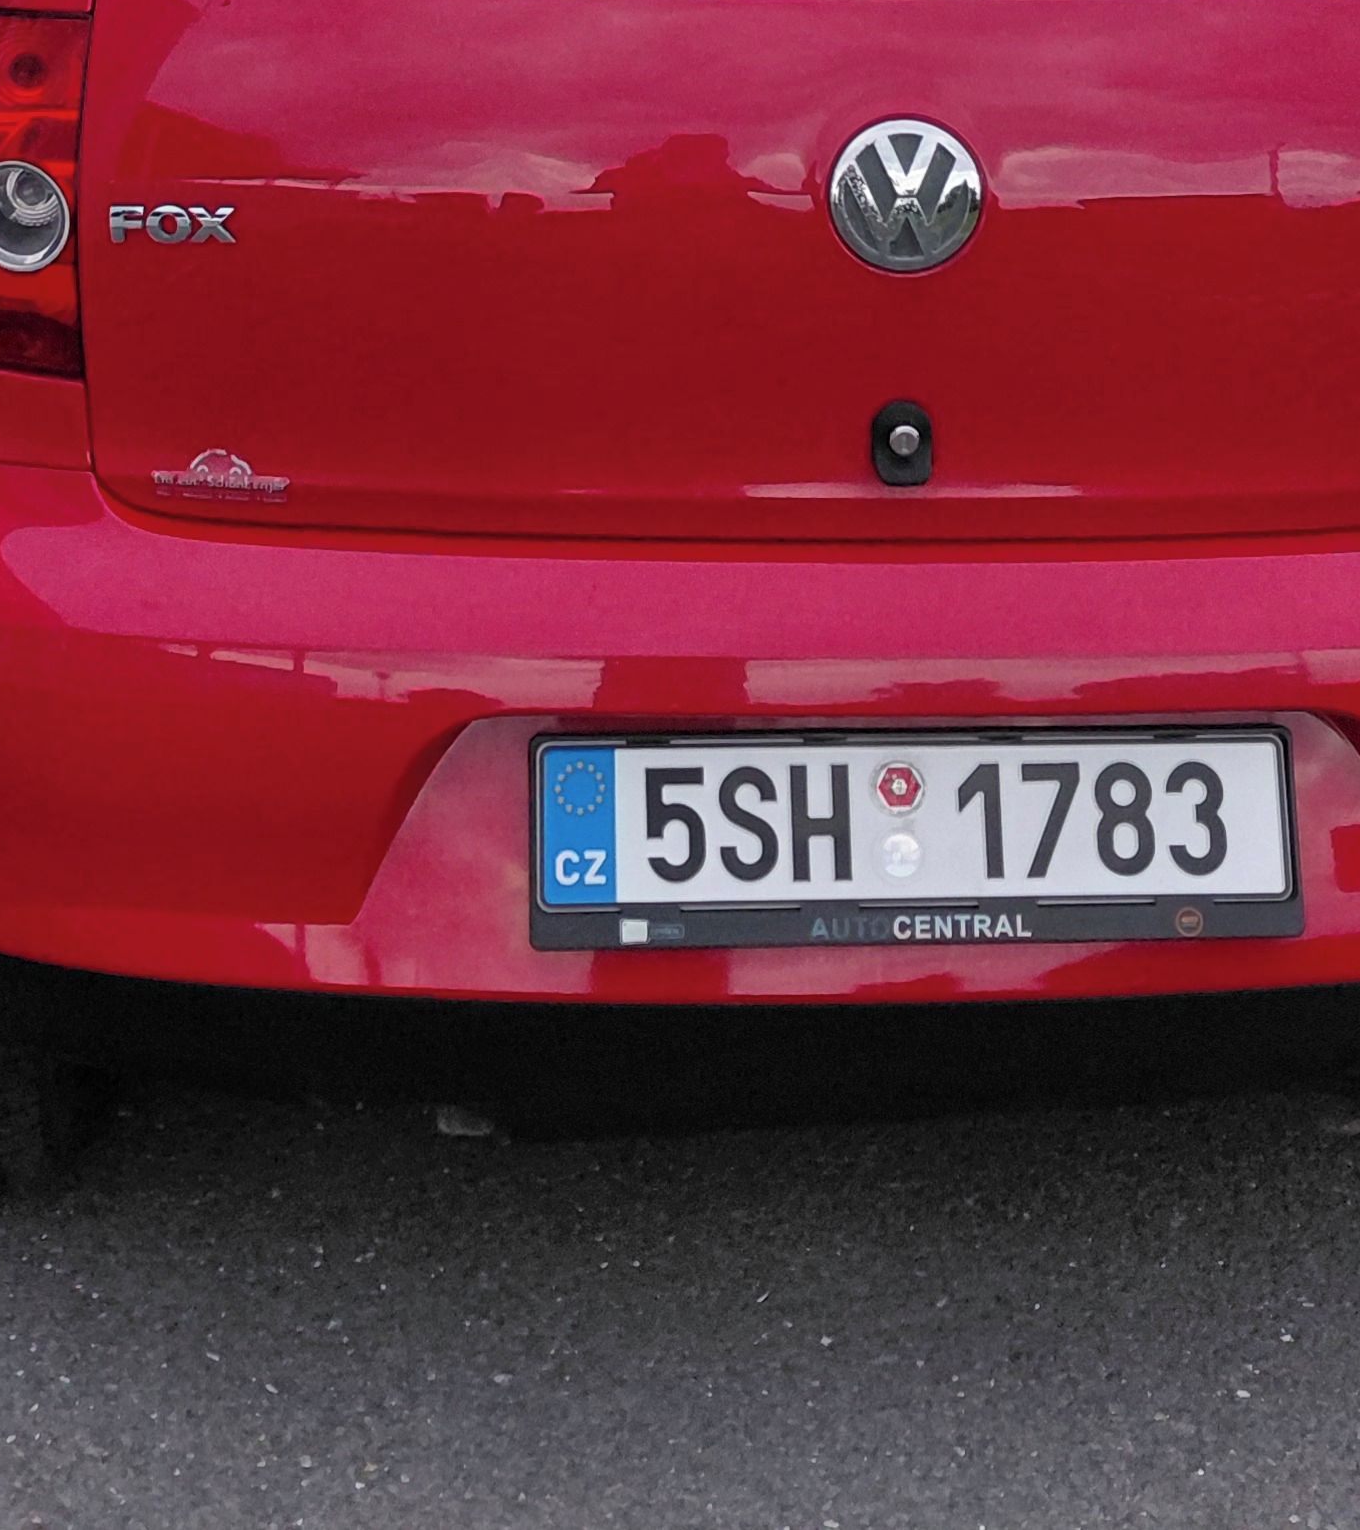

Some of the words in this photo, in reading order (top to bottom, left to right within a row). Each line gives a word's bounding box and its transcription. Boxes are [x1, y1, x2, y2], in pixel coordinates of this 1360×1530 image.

[108, 204, 236, 244] FOX
[644, 763, 853, 884] 5SH
[956, 759, 1228, 880] 1783
[555, 849, 608, 886] CZ
